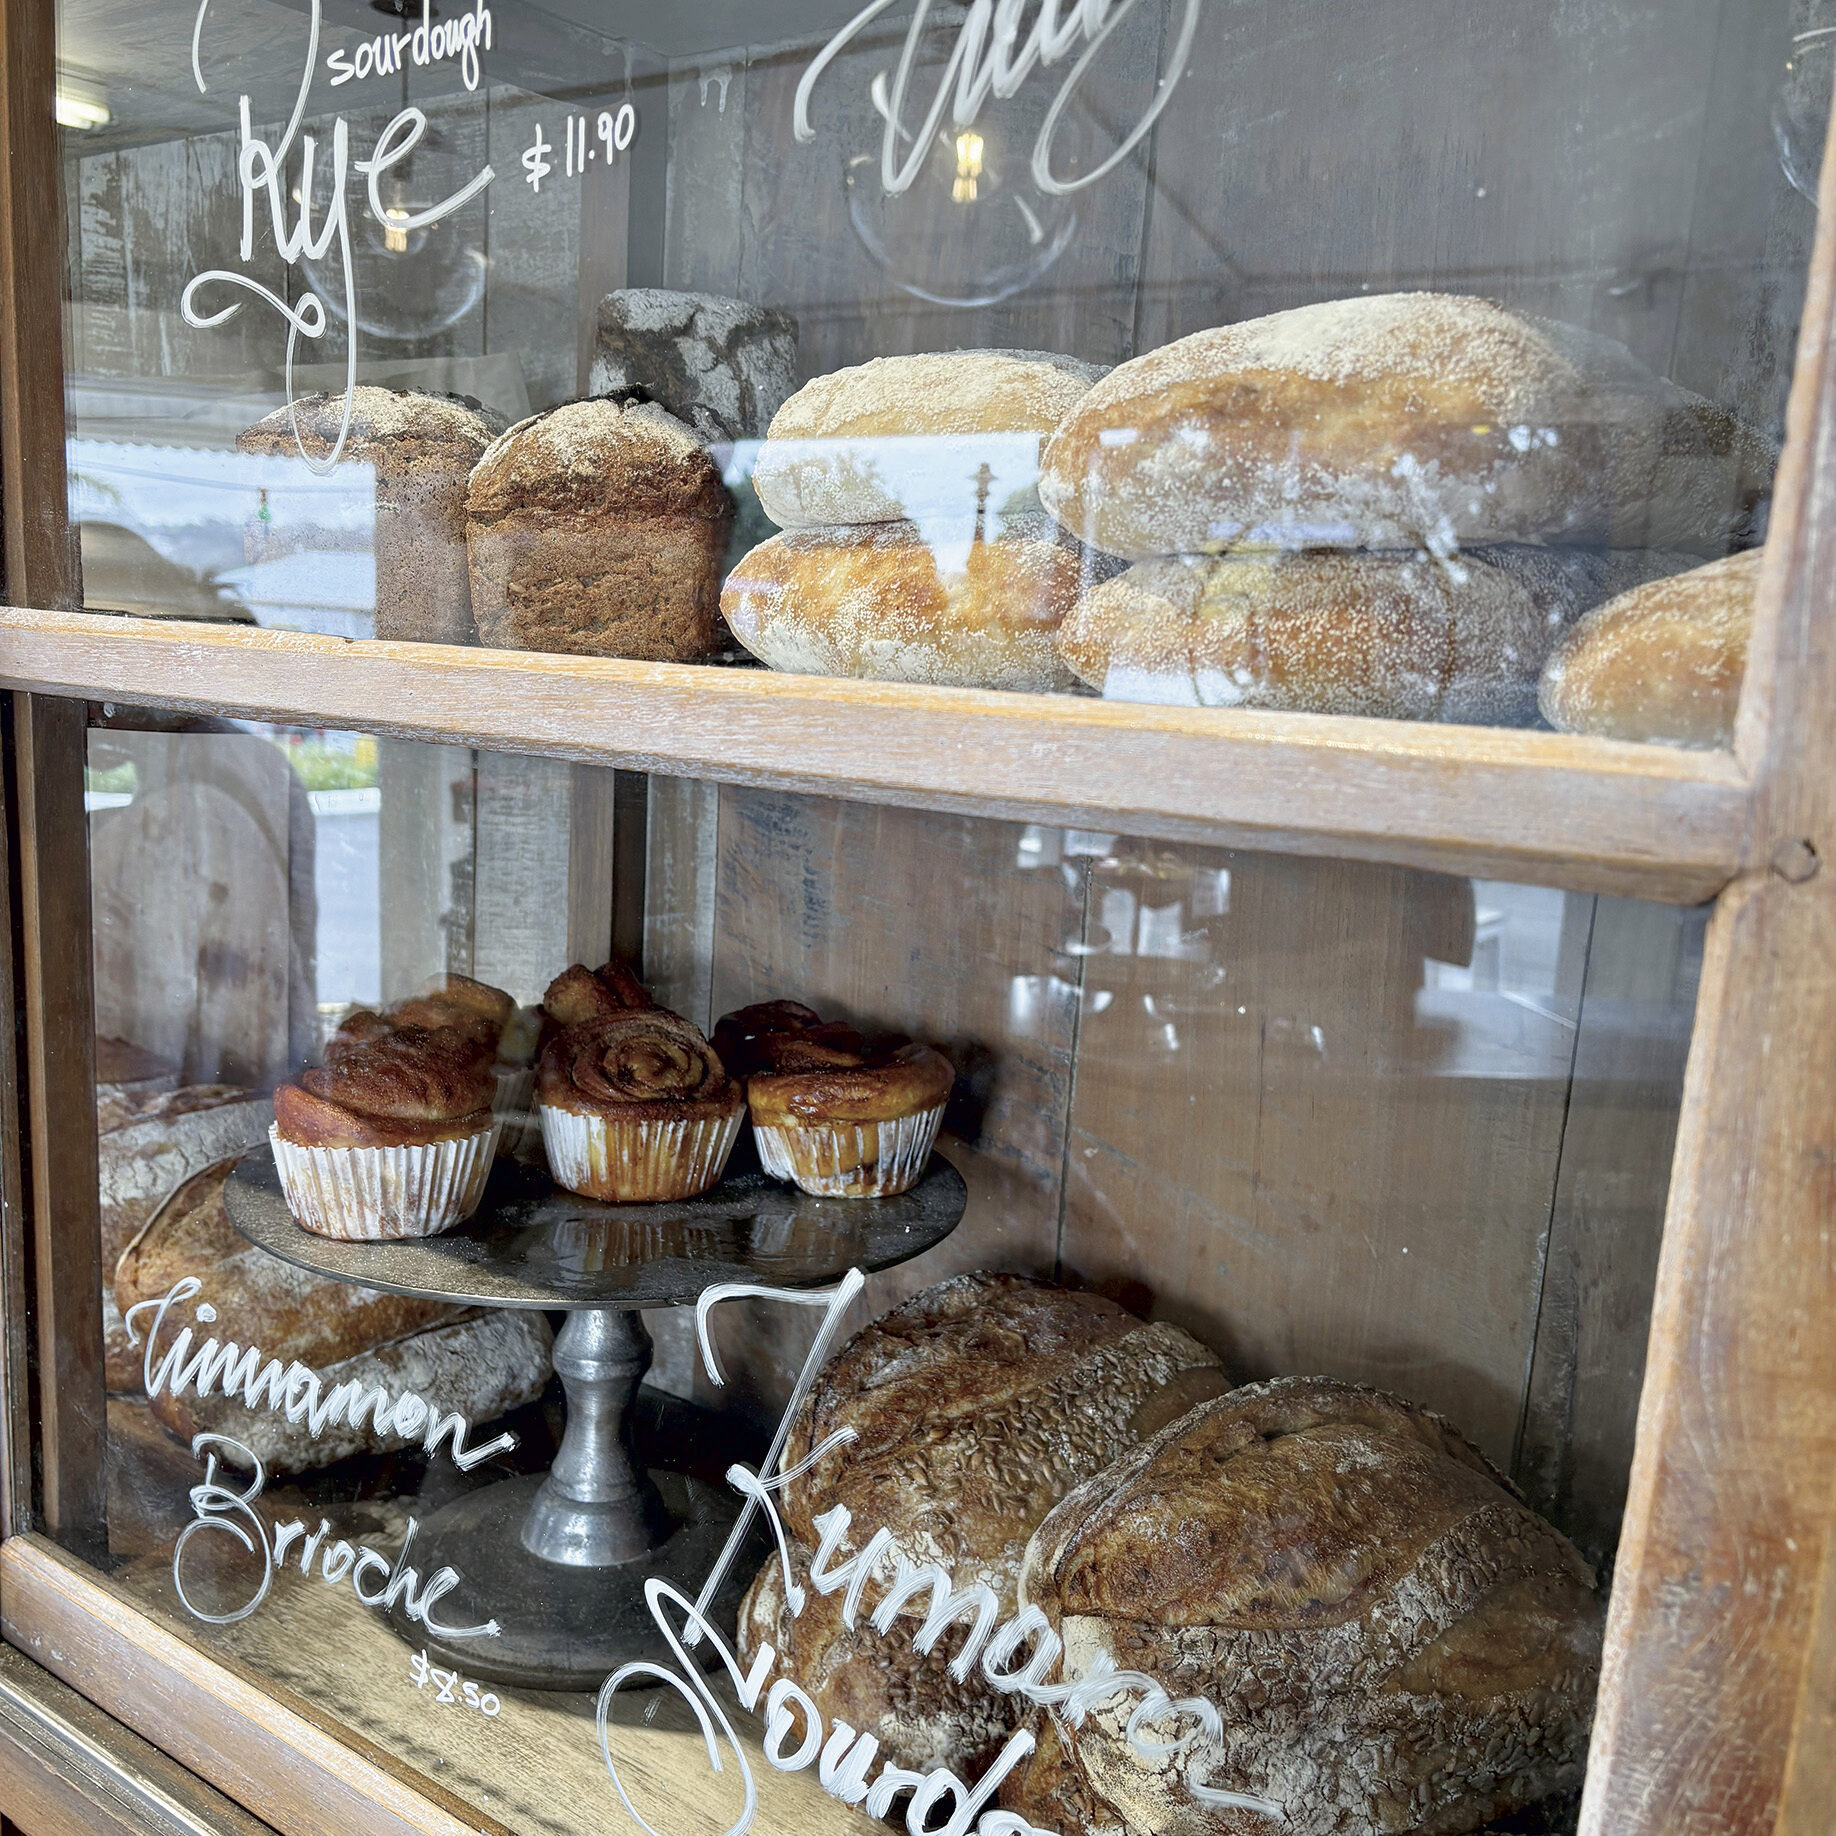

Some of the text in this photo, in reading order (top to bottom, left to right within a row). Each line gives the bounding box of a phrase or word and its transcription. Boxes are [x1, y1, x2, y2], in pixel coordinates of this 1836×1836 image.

[327, 0, 492, 91] sourdough
[181, 0, 496, 475] Rye
[173, 1433, 502, 1638] Brioche
[408, 1648, 501, 1716] $8.50
